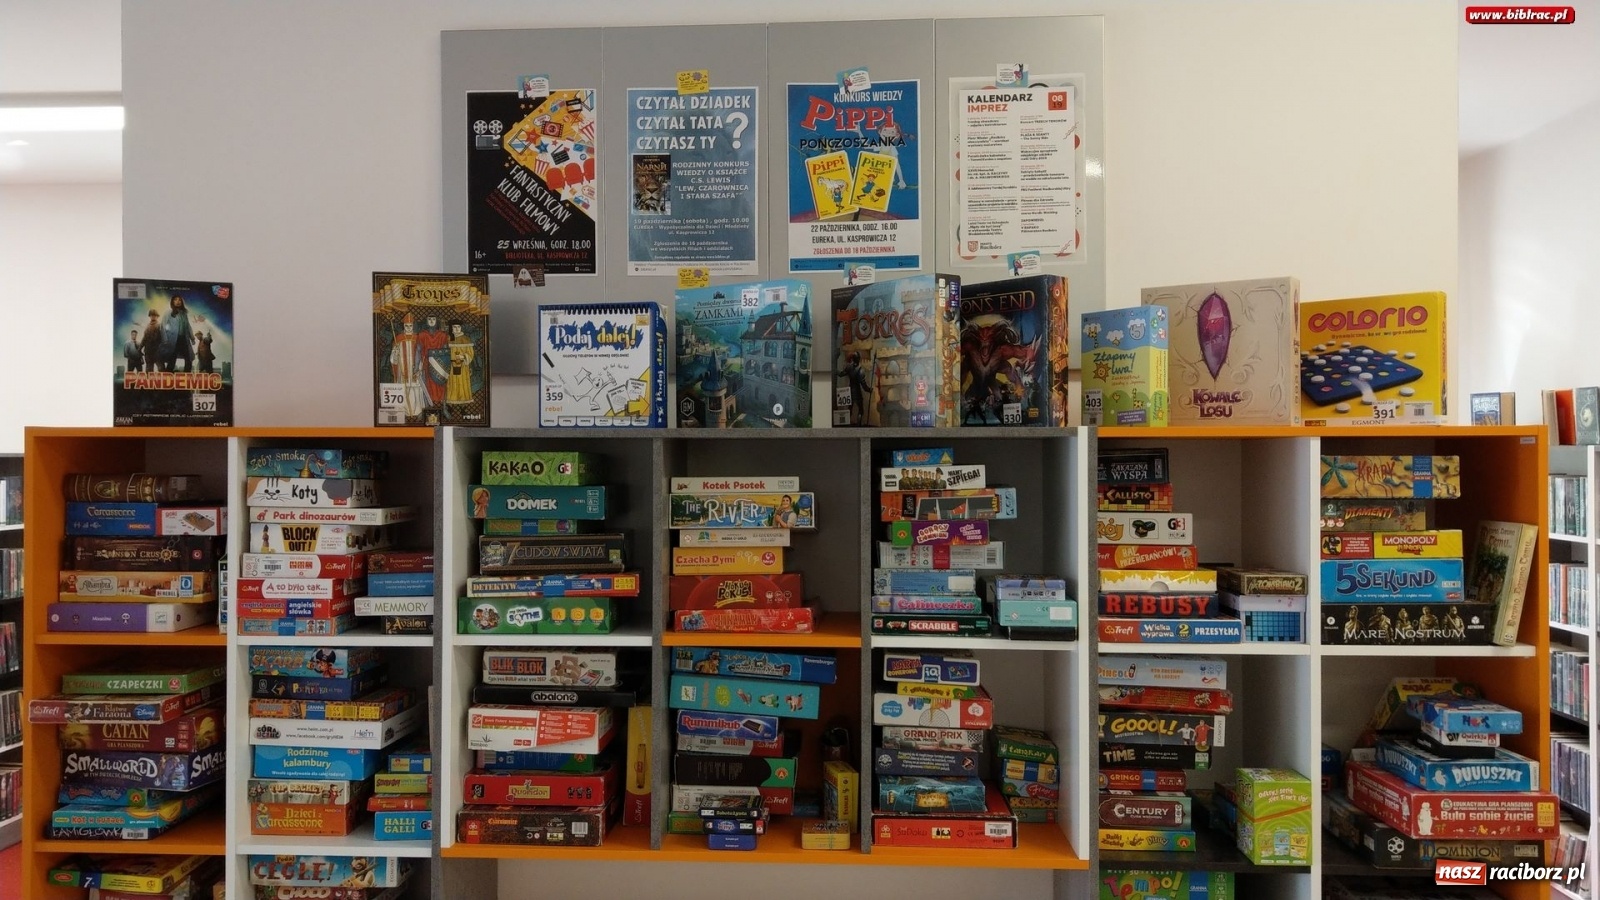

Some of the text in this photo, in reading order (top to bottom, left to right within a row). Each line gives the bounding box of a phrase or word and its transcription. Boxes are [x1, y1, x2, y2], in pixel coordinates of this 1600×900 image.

[833, 90, 903, 102] KONKURS WIEDZY
[967, 94, 1033, 103] KALENDARZ
[636, 96, 751, 110] CZYTAŁ DZIADEK
[967, 104, 1008, 113] IMPREZ
[636, 112, 749, 149] CZYTAŁ TATA ?
[636, 136, 716, 149] CZYTASZ TY
[509, 164, 573, 223] FANTASTYCZNY
[497, 178, 522, 203] KLUB
[520, 198, 560, 236] FILMOWY
[820, 223, 861, 232] PAŹDZIERNIKA,
[863, 223, 879, 231] GODZ.
[497, 238, 591, 250] 25 WRZEŚNIA, GODZ. 18.00
[847, 234, 888, 242] KASPROWICZA
[475, 250, 486, 259] 16+
[402, 285, 461, 302] Troyes
[743, 298, 758, 306] 382
[1000, 291, 1035, 311] END
[695, 307, 743, 320] ZAMKAMI
[836, 305, 931, 346] TORRES
[555, 324, 636, 350] Podaj dalej!
[124, 372, 222, 390] PANDEMIC
[384, 395, 404, 404] 370
[546, 393, 563, 401] 359
[838, 397, 851, 406] 406
[1085, 399, 1101, 407] 403
[195, 402, 215, 410] 307
[1200, 405, 1232, 417] LOSU
[1004, 414, 1021, 423] 330
[1374, 409, 1395, 419] 391
[488, 461, 544, 476] KAKAO
[946, 469, 980, 486] SZPIEGA!
[1112, 471, 1147, 481] WYSPA
[734, 481, 765, 489] Psotek
[292, 485, 318, 504] Koty
[1106, 489, 1152, 501] CALLISTO
[506, 498, 558, 510] DOMEK
[683, 500, 701, 514] THE
[273, 512, 356, 521] Park dinozaurów
[1345, 507, 1395, 519] DIAMENTY
[282, 527, 318, 540] BLOCK
[676, 556, 735, 565] Czacha Dymi
[1336, 563, 1437, 595] 5 SEKUND
[266, 583, 274, 591] A
[473, 582, 516, 591] DETEKTYW
[374, 602, 428, 612] MEMMORY
[1106, 594, 1210, 615] REBUSY
[911, 622, 956, 630] SCRABBLE
[1115, 626, 1133, 634] Trefl
[1195, 627, 1239, 636] PRZESYŁKA
[1344, 627, 1466, 639] MARE NOSTRUM
[491, 658, 544, 674] BLIK BLOK
[107, 680, 163, 689] CZAPECZKI
[93, 708, 131, 718] Faraona
[682, 716, 741, 730] Rummikub
[1111, 718, 1177, 735] GOOOL!
[103, 724, 149, 739] CATAN
[904, 730, 962, 739] GRAND PRIX
[288, 748, 329, 757] Rodzinne
[1103, 749, 1136, 762] TIME
[283, 759, 331, 769] kalambury
[284, 808, 316, 818] Dzieci
[1114, 804, 1168, 817] CENTURY
[1470, 811, 1501, 821] sobie
[1504, 809, 1534, 821] życie
